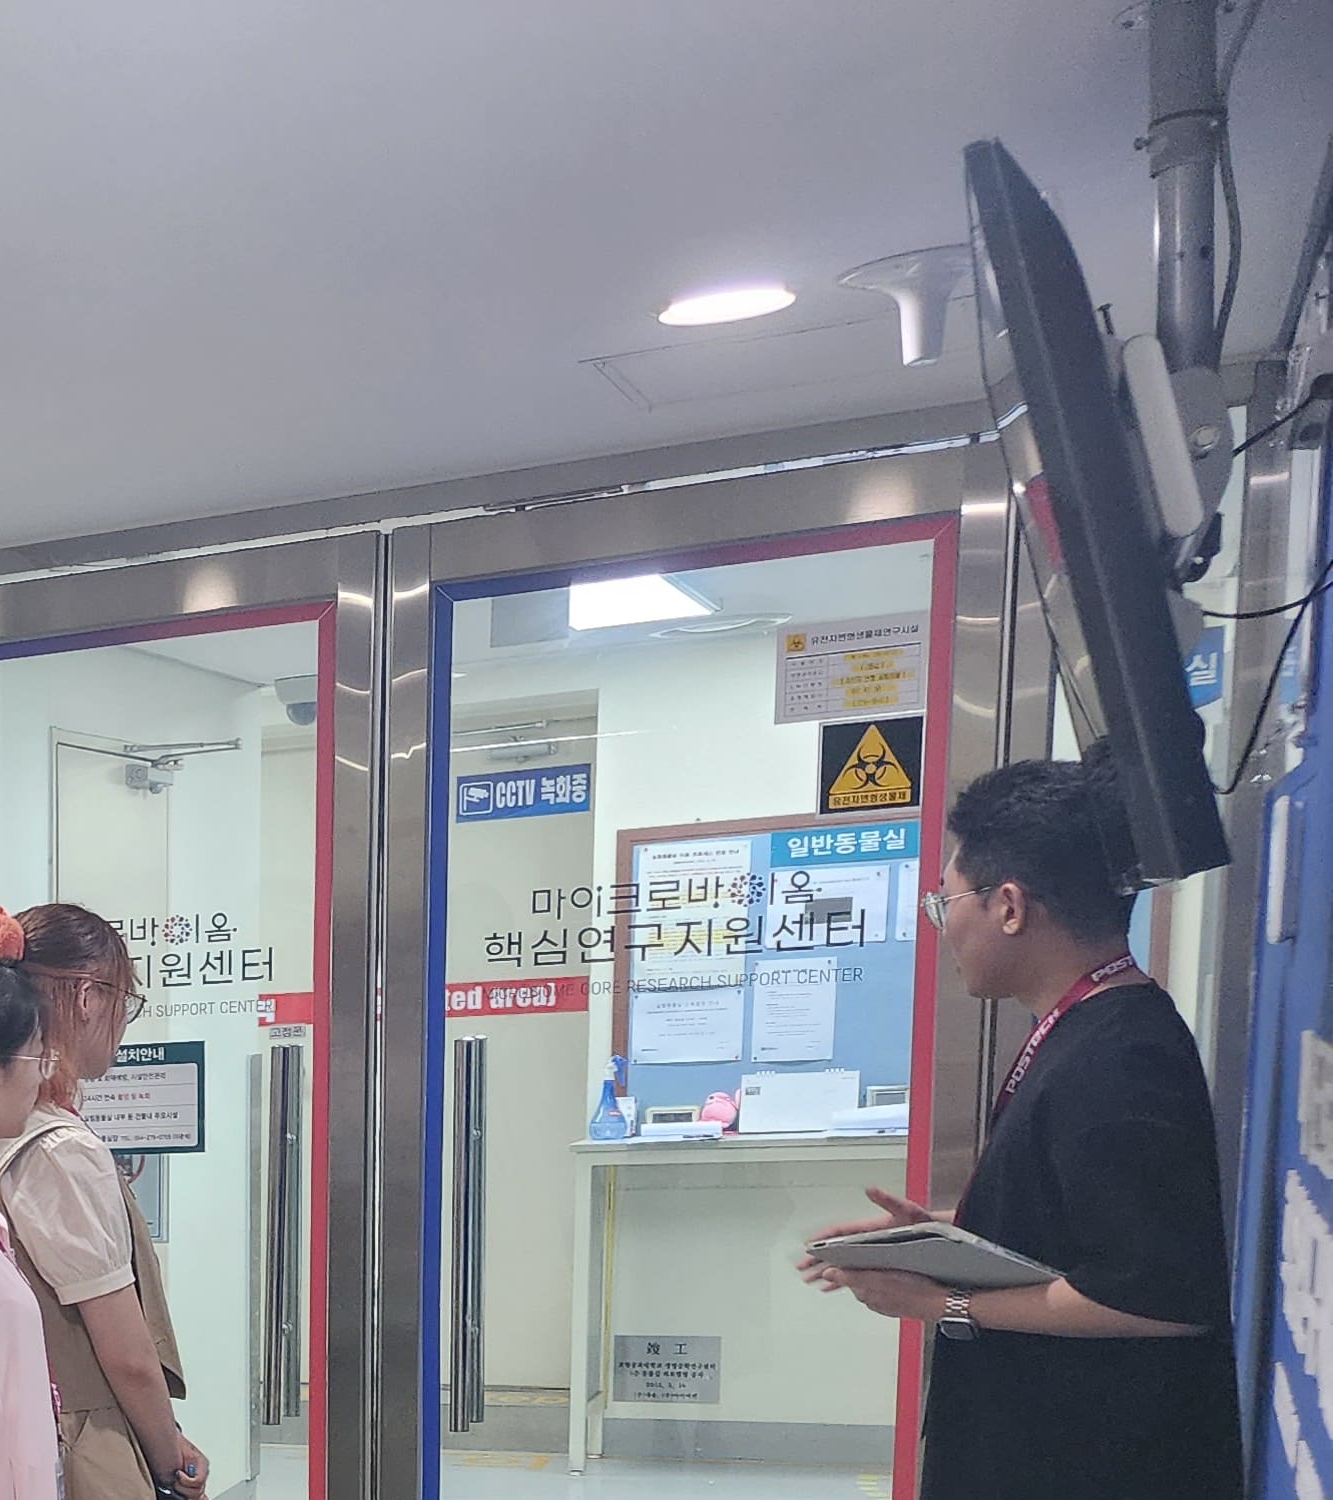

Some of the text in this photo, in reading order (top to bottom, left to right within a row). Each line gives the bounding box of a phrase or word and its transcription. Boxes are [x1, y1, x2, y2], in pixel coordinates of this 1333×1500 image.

[1185, 652, 1218, 687] 실
[496, 773, 587, 809] CCTV 녹화중
[787, 828, 906, 859] 일반동물실
[484, 908, 866, 968] 핵심연구지원센터
[130, 946, 274, 989] 지원센터
[627, 975, 711, 993] RESEARCH
[718, 972, 791, 988] SUPPORT
[796, 967, 863, 984] CENTER
[1092, 954, 1133, 983] POST
[156, 1001, 216, 1017] SUPPORT
[220, 998, 273, 1014] CENTER
[116, 1046, 165, 1063] 설치안내
